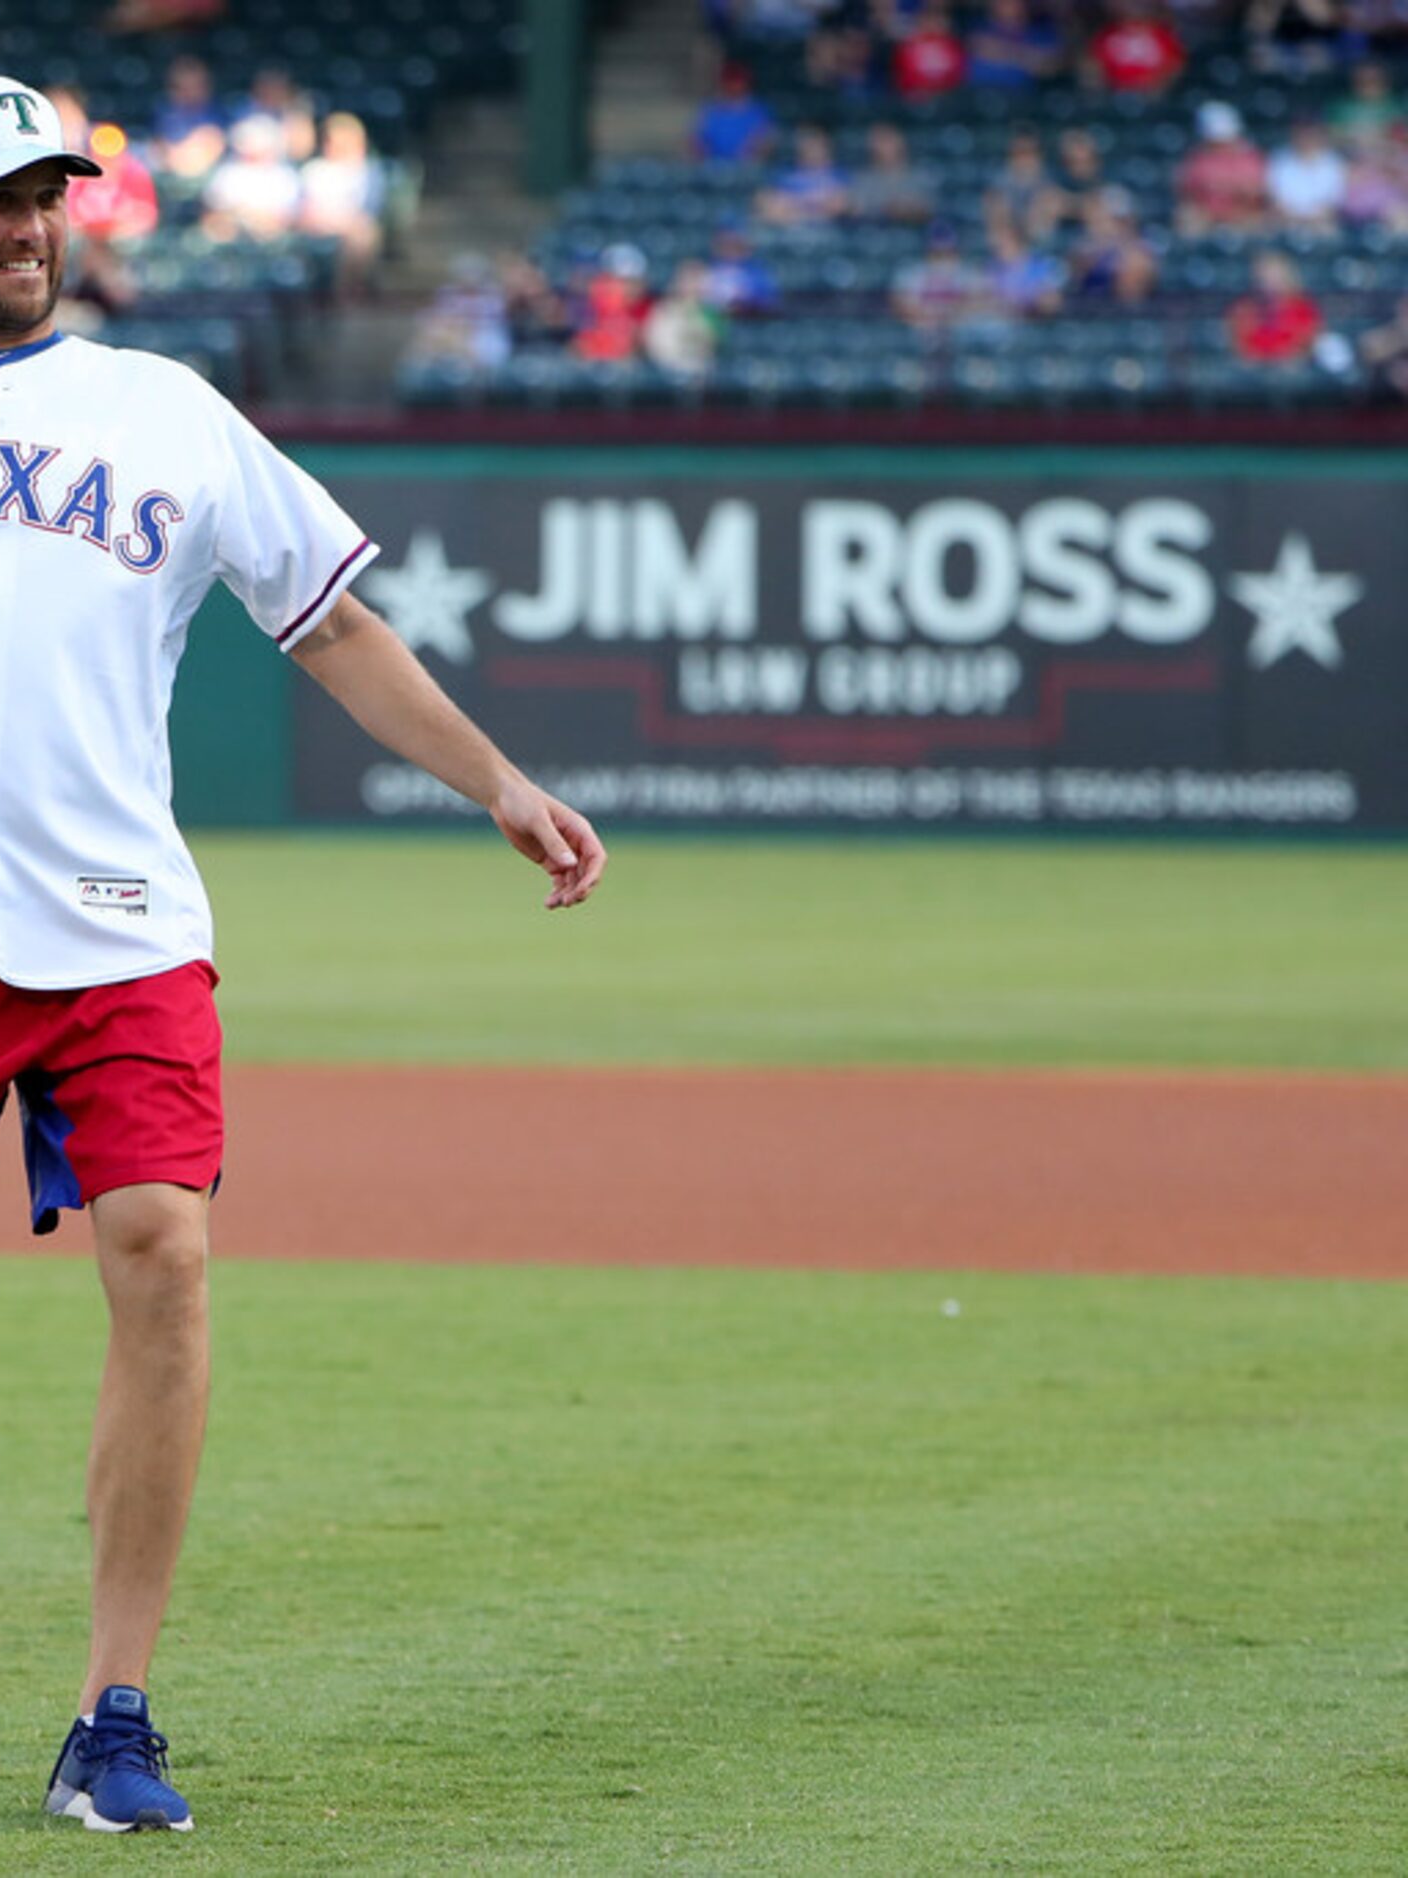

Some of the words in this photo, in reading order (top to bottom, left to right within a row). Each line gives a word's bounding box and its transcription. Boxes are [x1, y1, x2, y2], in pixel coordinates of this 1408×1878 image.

[495, 498, 758, 640] JIM
[802, 498, 1214, 643] ROSS
[679, 646, 807, 713] LAW
[818, 646, 1021, 713] GROUP
